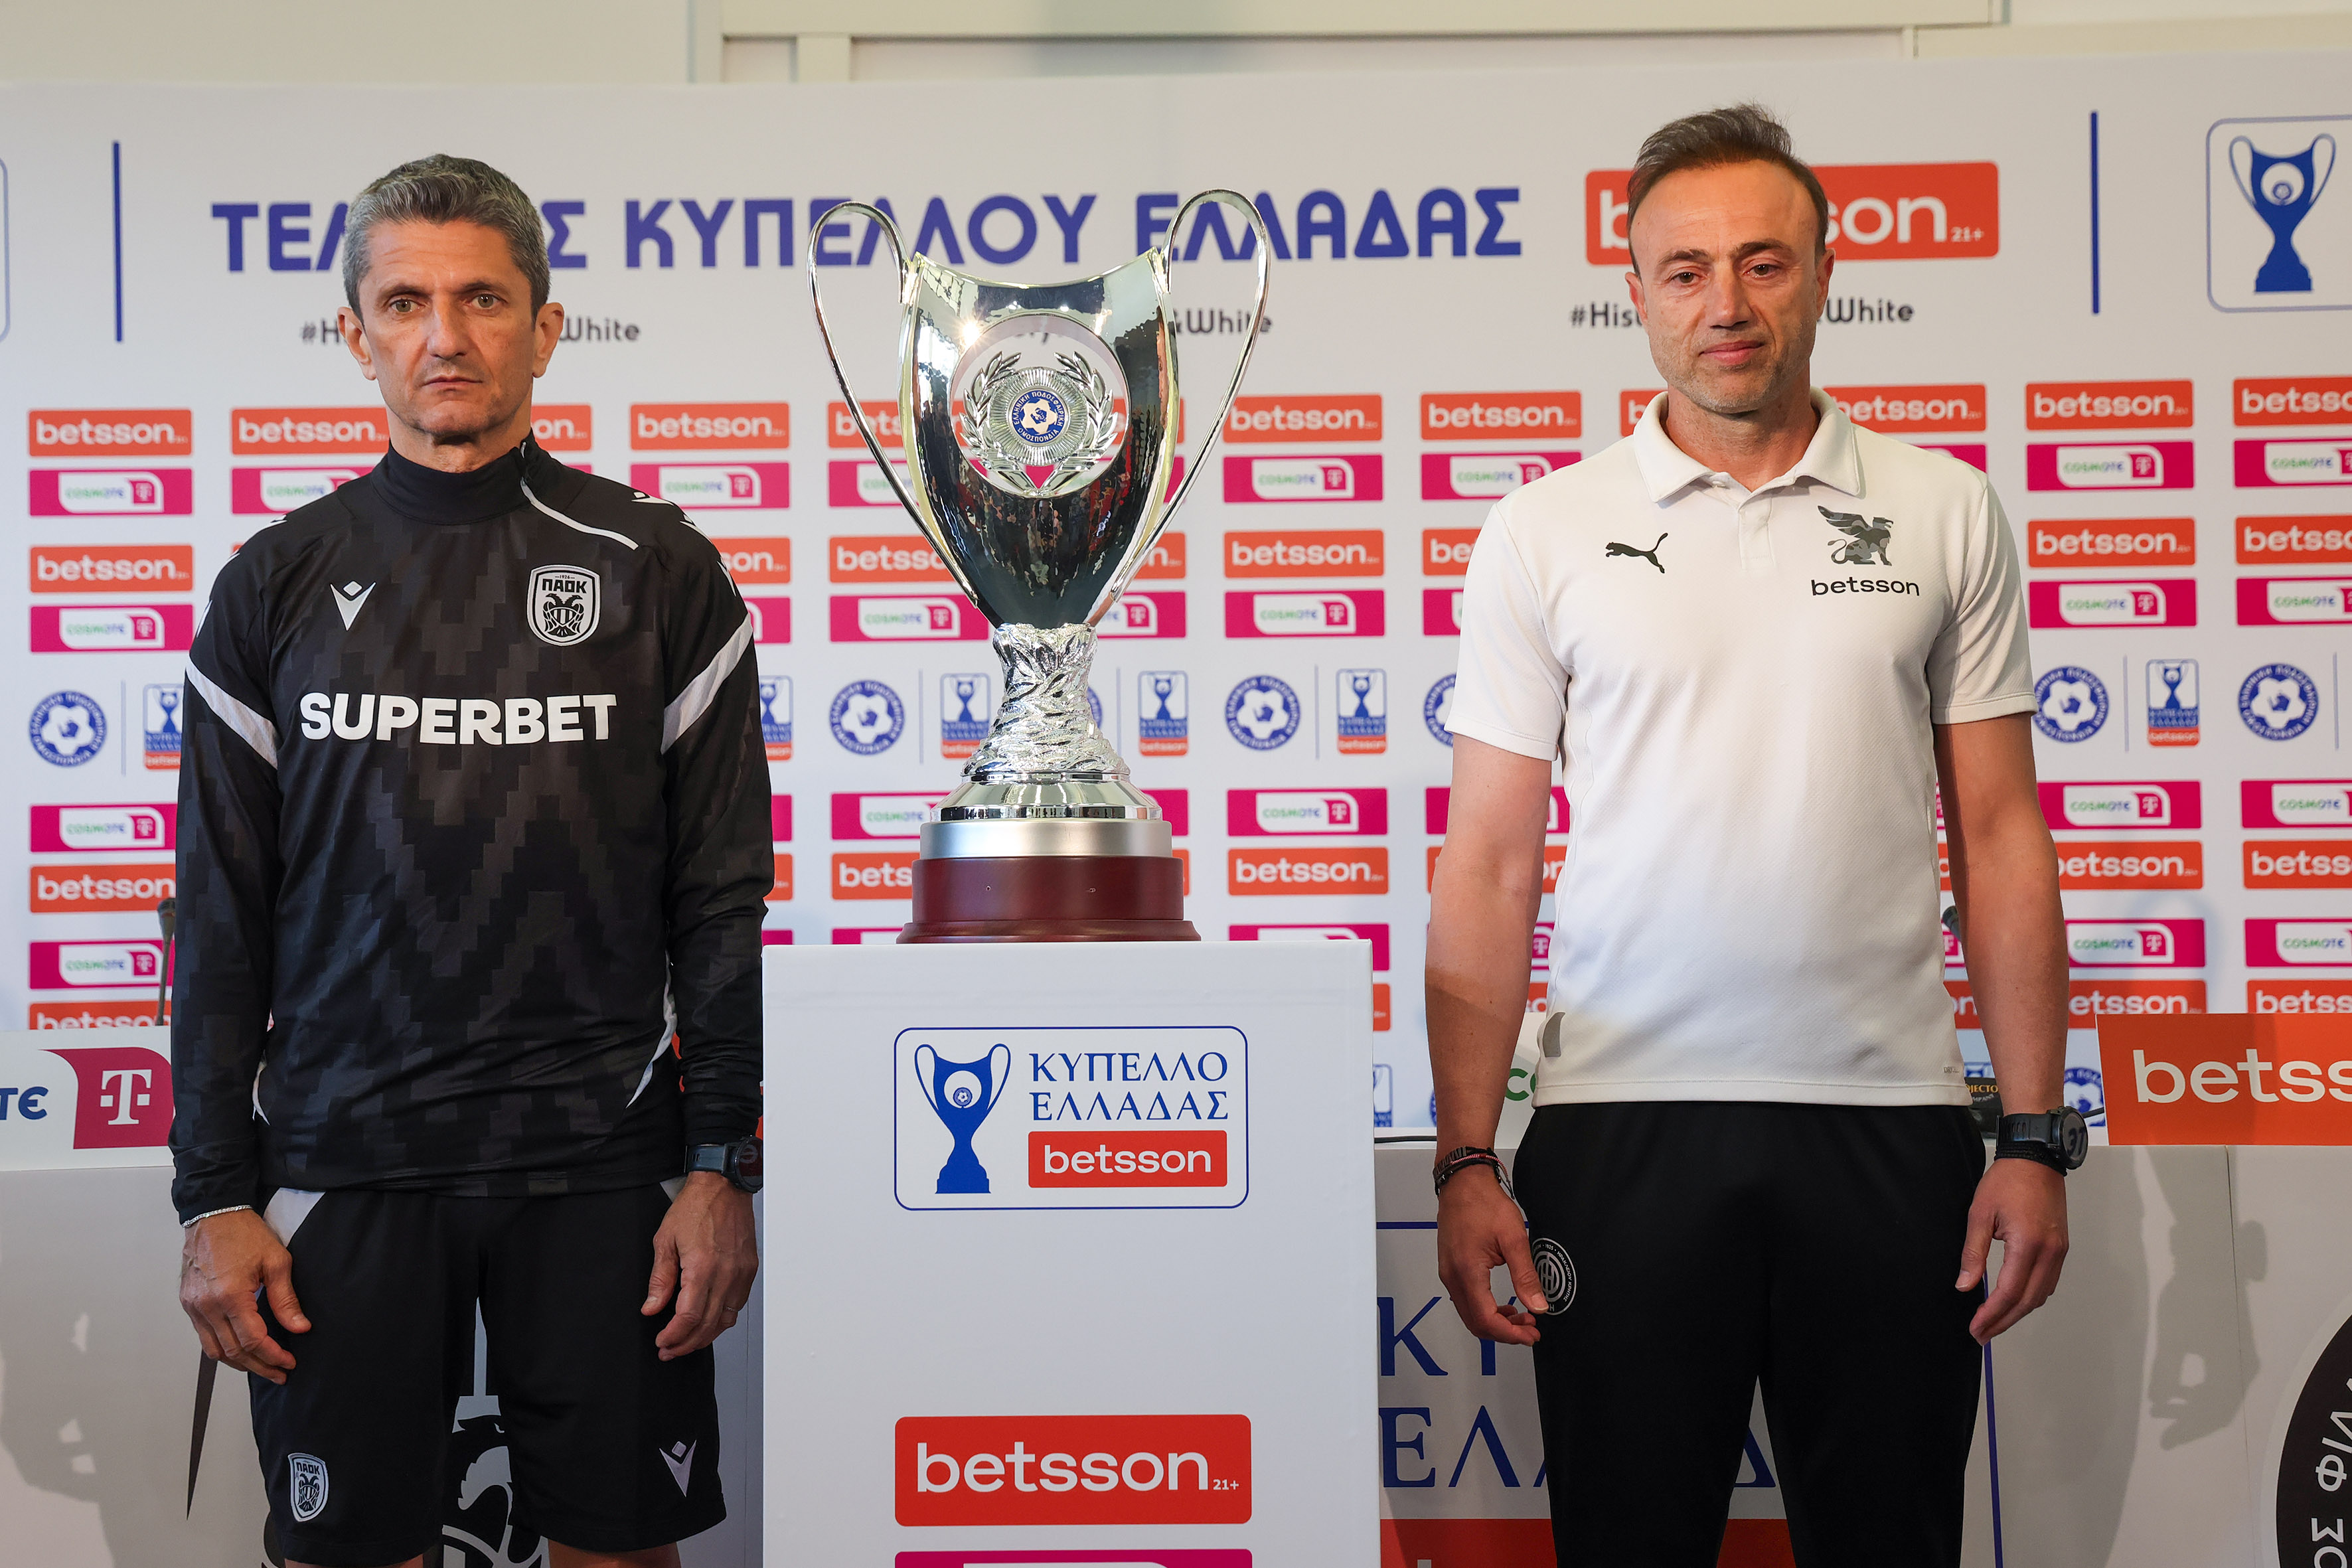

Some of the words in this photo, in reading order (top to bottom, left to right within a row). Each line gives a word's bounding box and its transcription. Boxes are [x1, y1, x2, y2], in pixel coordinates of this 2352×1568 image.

[625, 195, 1097, 268] ΚΥΠΕΛΛΟΥ
[1137, 187, 1522, 262] ΕΛΛΑΔΑΣ
[1951, 226, 1985, 242] 21+
[1013, 394, 1030, 426] ΕΛΛΗΝΙΚΗ
[1428, 402, 1563, 428] betsson
[2033, 392, 2174, 418] betsson
[238, 417, 374, 443] betsson
[637, 413, 772, 438] betsson
[1230, 406, 1365, 431] betsson
[36, 419, 174, 445] betsson
[1232, 541, 1367, 566] betsson
[2036, 529, 2177, 556] betsson
[37, 555, 176, 582] betsson
[836, 546, 943, 572] betsso
[1811, 576, 1921, 597] betsson
[299, 692, 618, 745] SUPERBET
[838, 862, 912, 888] bets
[1235, 858, 1371, 884] betsson
[37, 874, 175, 901] betsson
[2068, 990, 2189, 1013] etsson
[1029, 1052, 1228, 1082] ΚΥΠΕΛΛΟ
[1029, 1091, 1228, 1121] ΕΛΛΑΔΑΣ
[1044, 1144, 1212, 1174] betsson
[917, 1441, 1209, 1493] betsson
[1212, 1478, 1240, 1491] 21+
